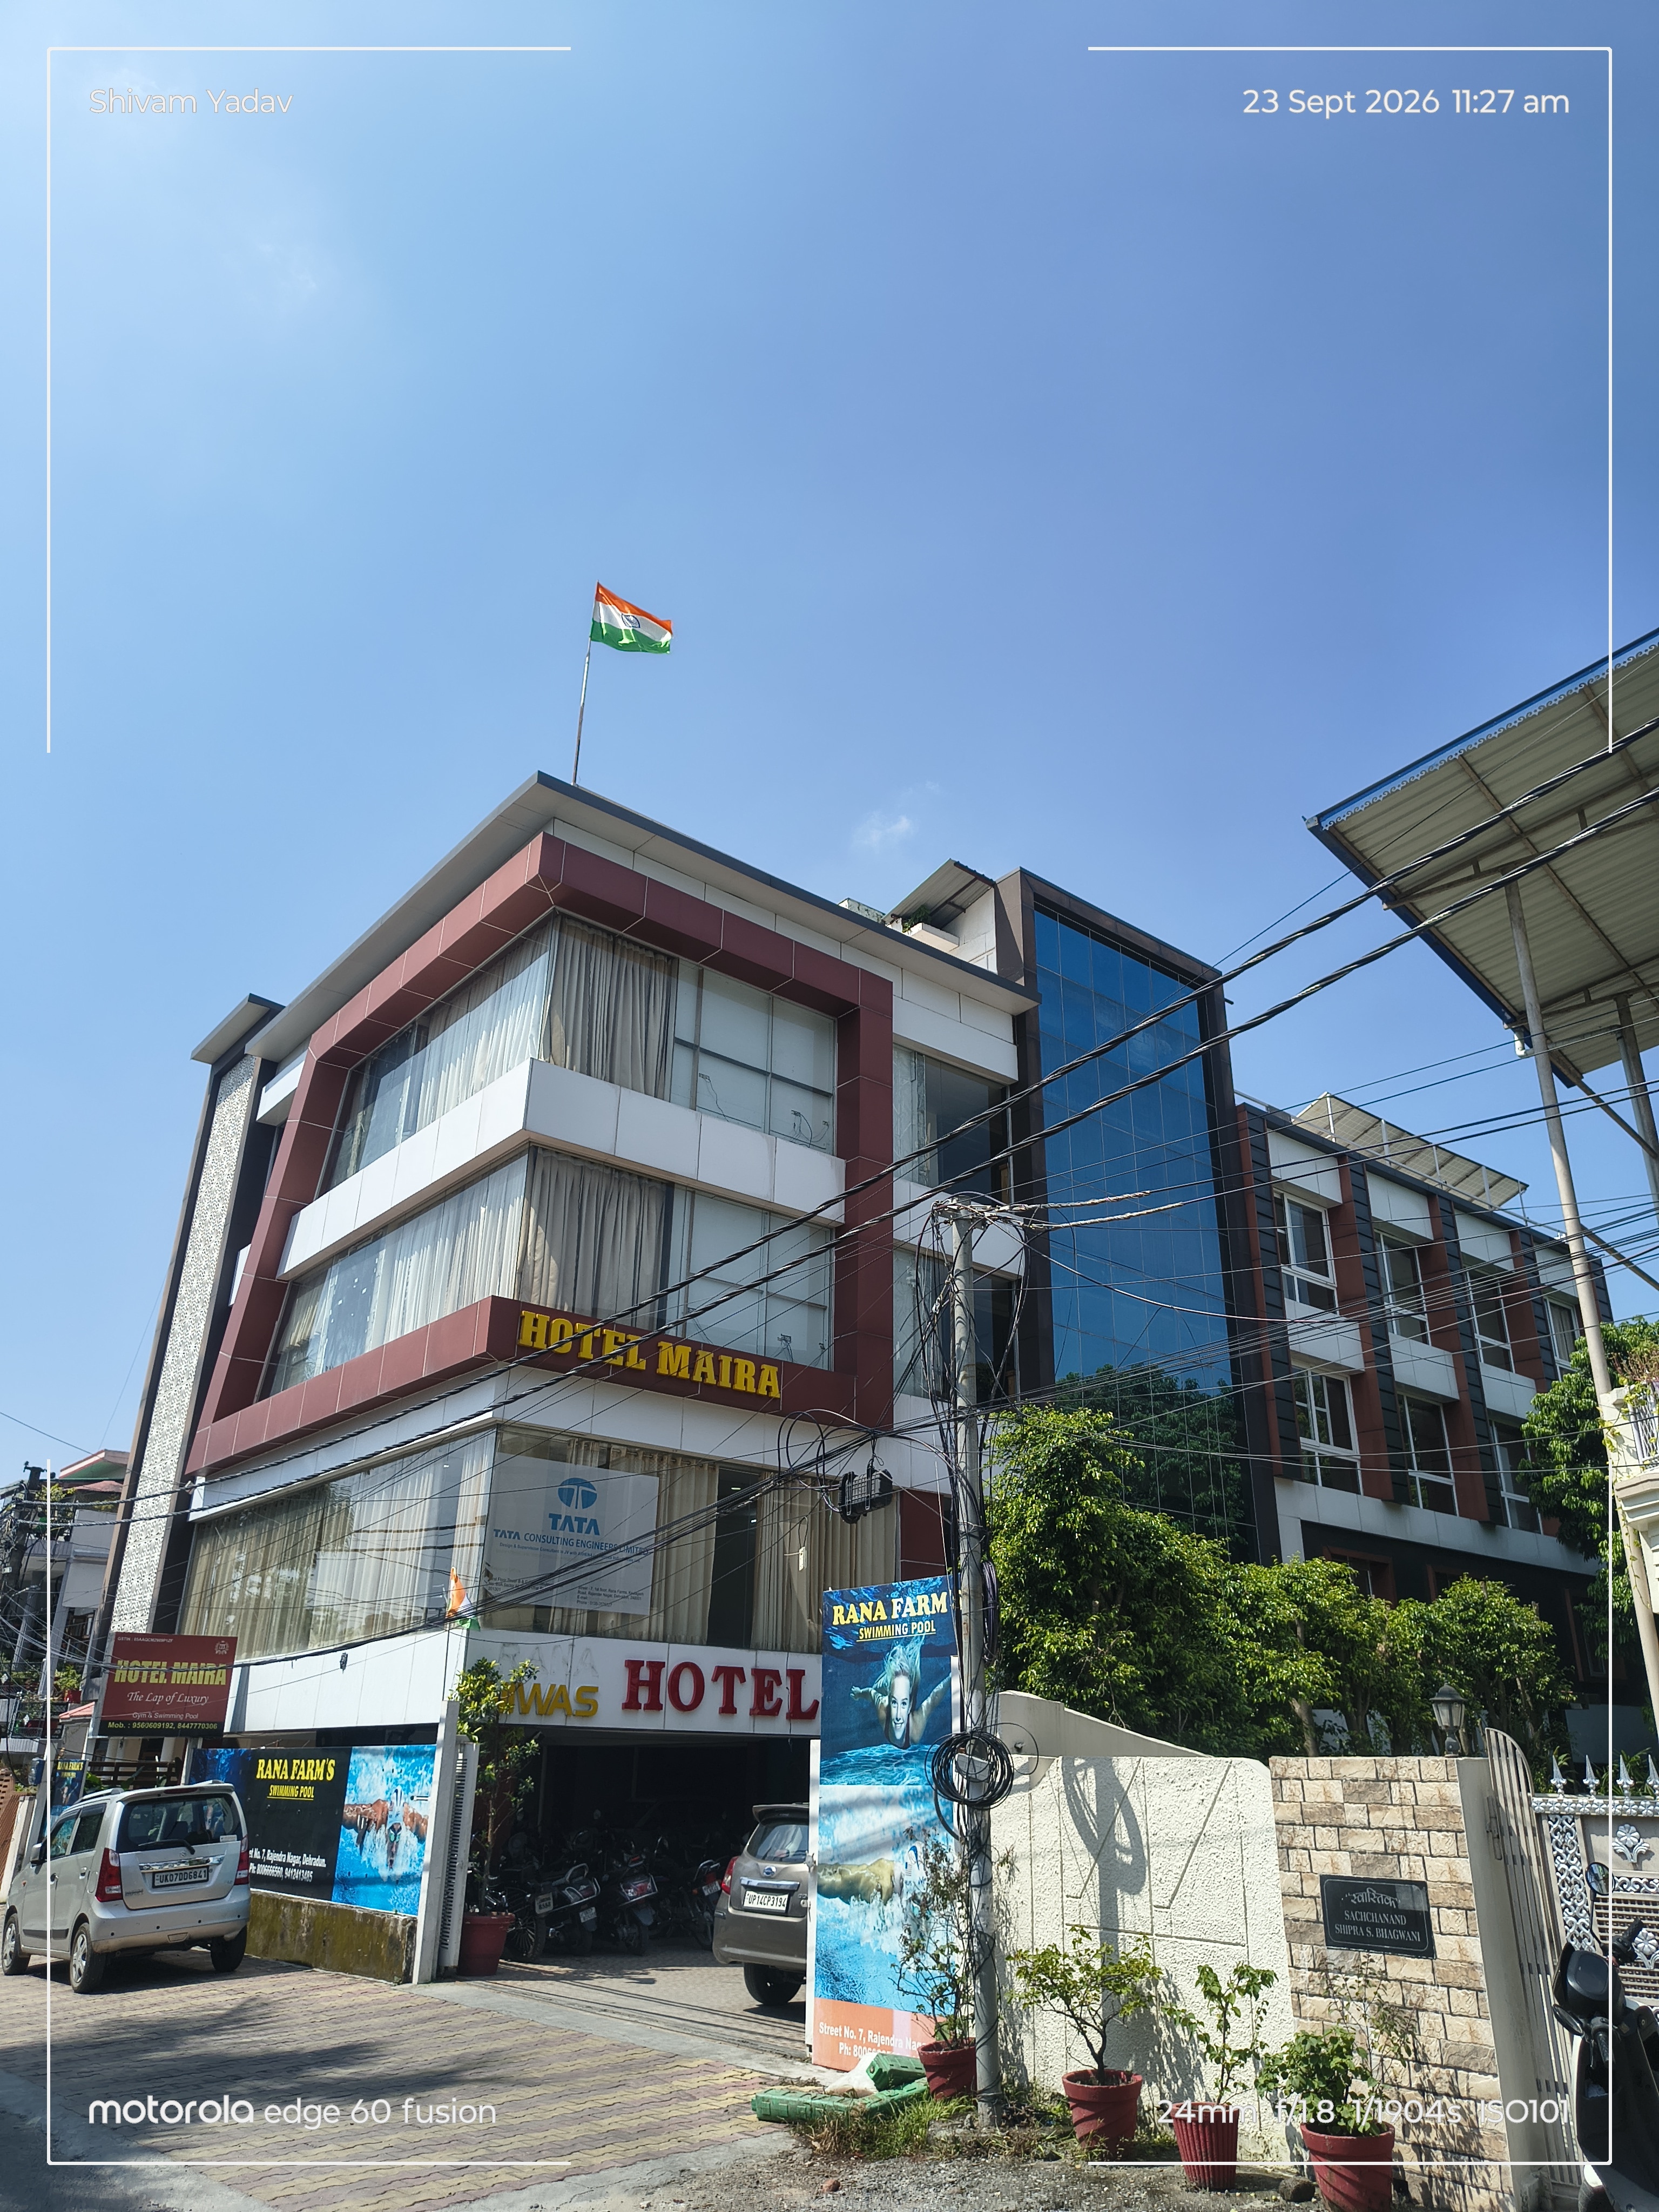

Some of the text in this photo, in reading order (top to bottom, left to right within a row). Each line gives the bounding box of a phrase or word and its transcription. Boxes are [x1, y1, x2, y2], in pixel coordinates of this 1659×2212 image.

[517, 1311, 780, 1398] HOTEL MAIRA
[548, 1513, 600, 1535] TATA
[494, 1529, 521, 1540] TATA
[524, 1533, 574, 1547] CONSULTING
[832, 1600, 887, 1625] RANA
[859, 1620, 936, 1640] SWIMMING POOL
[114, 1660, 226, 1685] HOTEL MAIRA
[127, 1691, 208, 1705] The Lap of Luxury
[484, 1660, 820, 1720] IWAS HOTEL
[257, 1758, 335, 1781] RANA FARM'S
[269, 1785, 314, 1798] SWIMMING POOL
[266, 1850, 286, 1864] Rajendra
[159, 1870, 207, 1883] UK07DD6841
[748, 1894, 787, 1907] UP14CP3194
[1344, 1910, 1406, 1925] SACHCHANAND
[1335, 1924, 1421, 1941] SHIPRA S. BHAGWANI
[819, 2022, 842, 2037] Street
[844, 2026, 856, 2040] No.
[859, 2028, 866, 2044] 7,
[868, 2030, 903, 2047] Rajendra
[839, 2042, 851, 2056] Ph:
